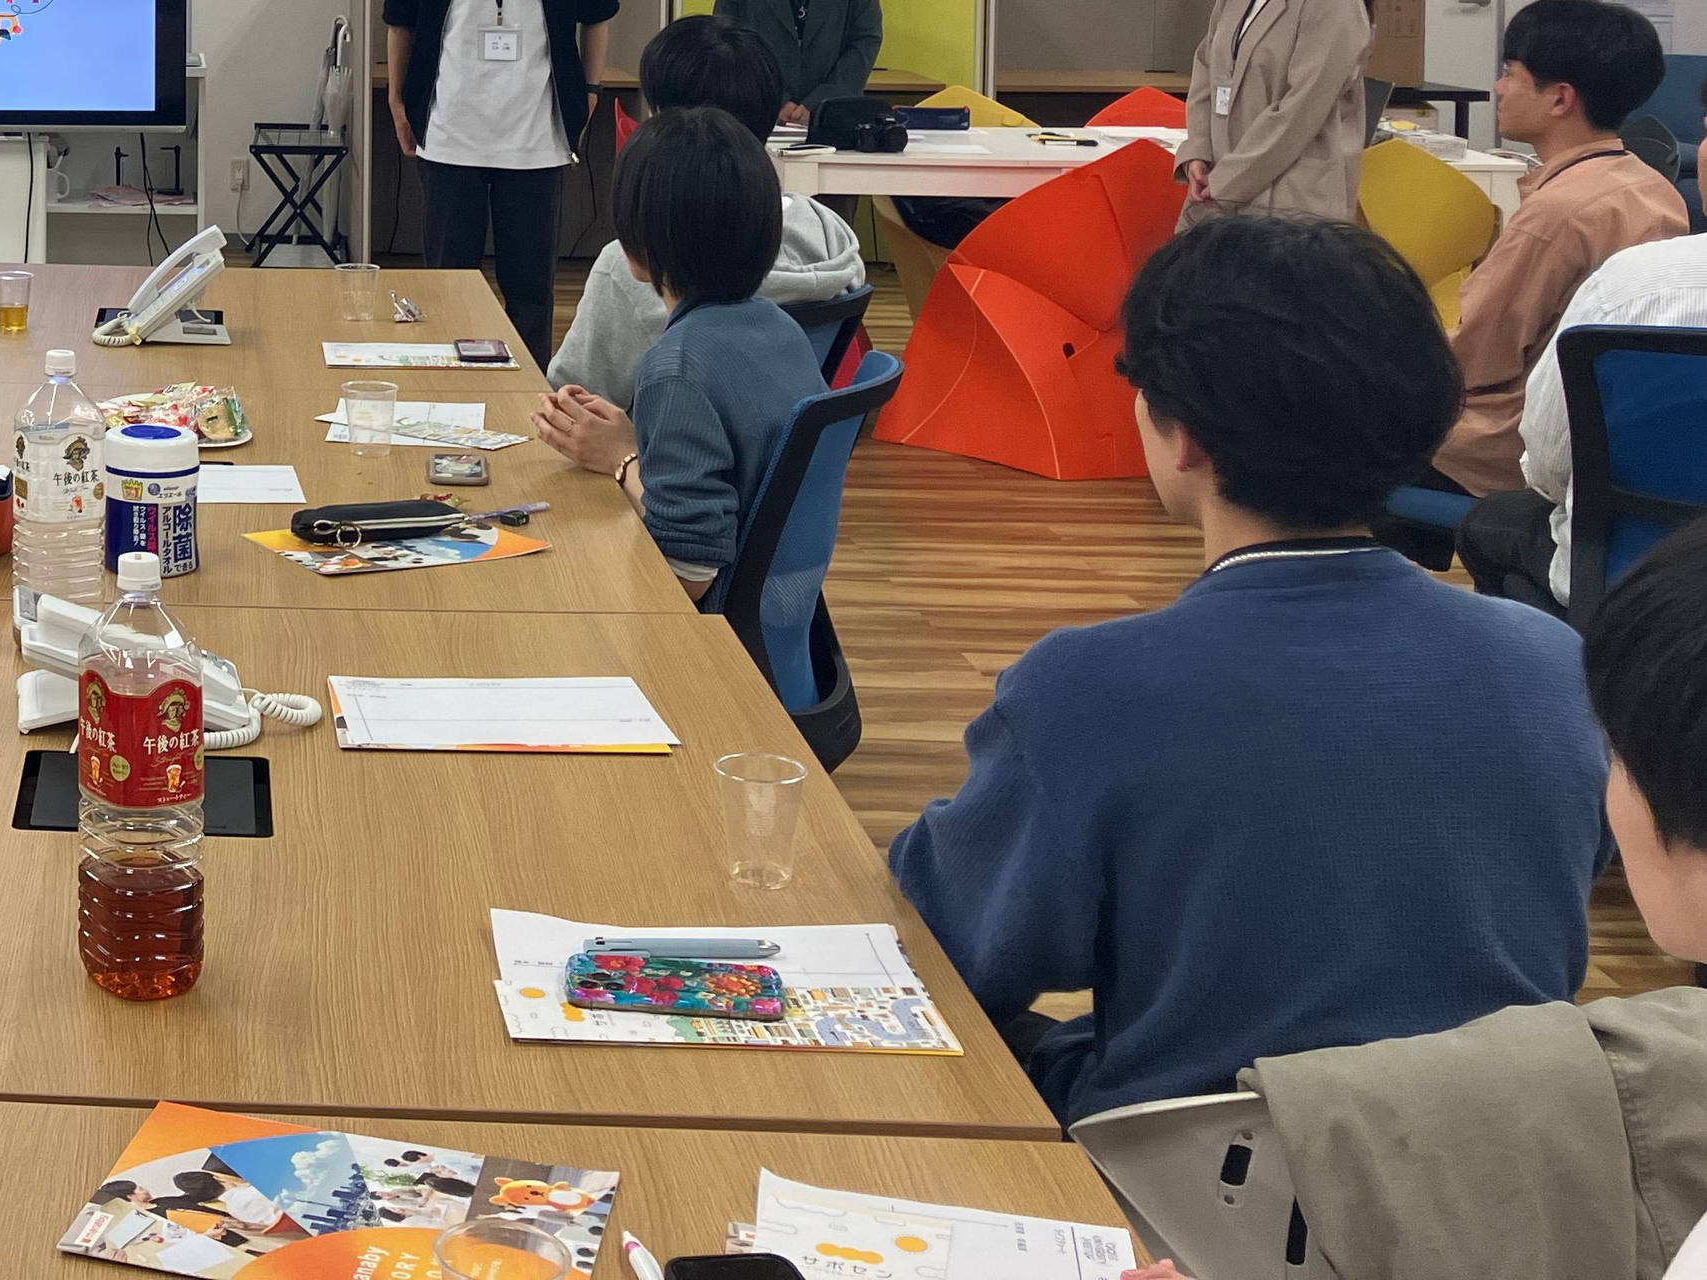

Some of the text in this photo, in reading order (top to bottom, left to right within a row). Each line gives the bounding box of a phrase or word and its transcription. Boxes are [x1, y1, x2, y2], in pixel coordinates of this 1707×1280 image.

[53, 469, 100, 486] 午後の紅茶
[162, 506, 173, 574] アルコールタオル
[173, 503, 193, 563] 除菌
[174, 562, 194, 573] できる
[79, 716, 117, 753] 午後の紅茶
[143, 729, 200, 755] 午後の紅茶
[352, 1245, 390, 1280] anaby
[802, 1255, 893, 1279] サポセン
